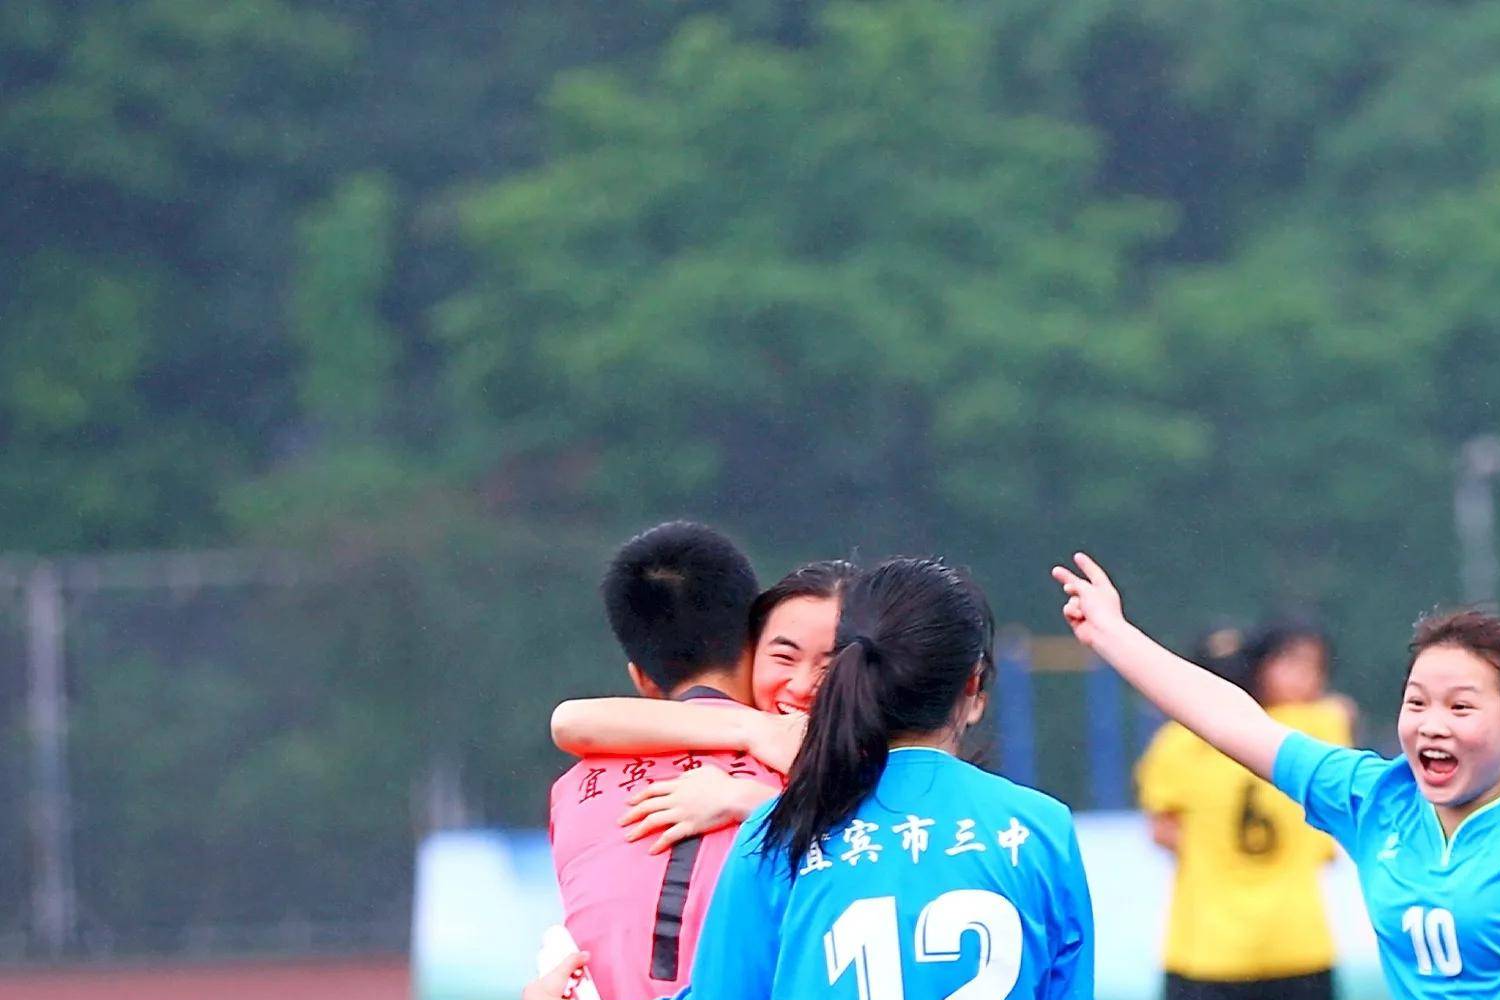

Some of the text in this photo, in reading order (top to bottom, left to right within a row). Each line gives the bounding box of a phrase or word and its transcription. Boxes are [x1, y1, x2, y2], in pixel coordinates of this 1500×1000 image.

[799, 815, 1030, 876] 宜宾市三中
[1235, 782, 1279, 856] 6
[1402, 905, 1463, 977] 10
